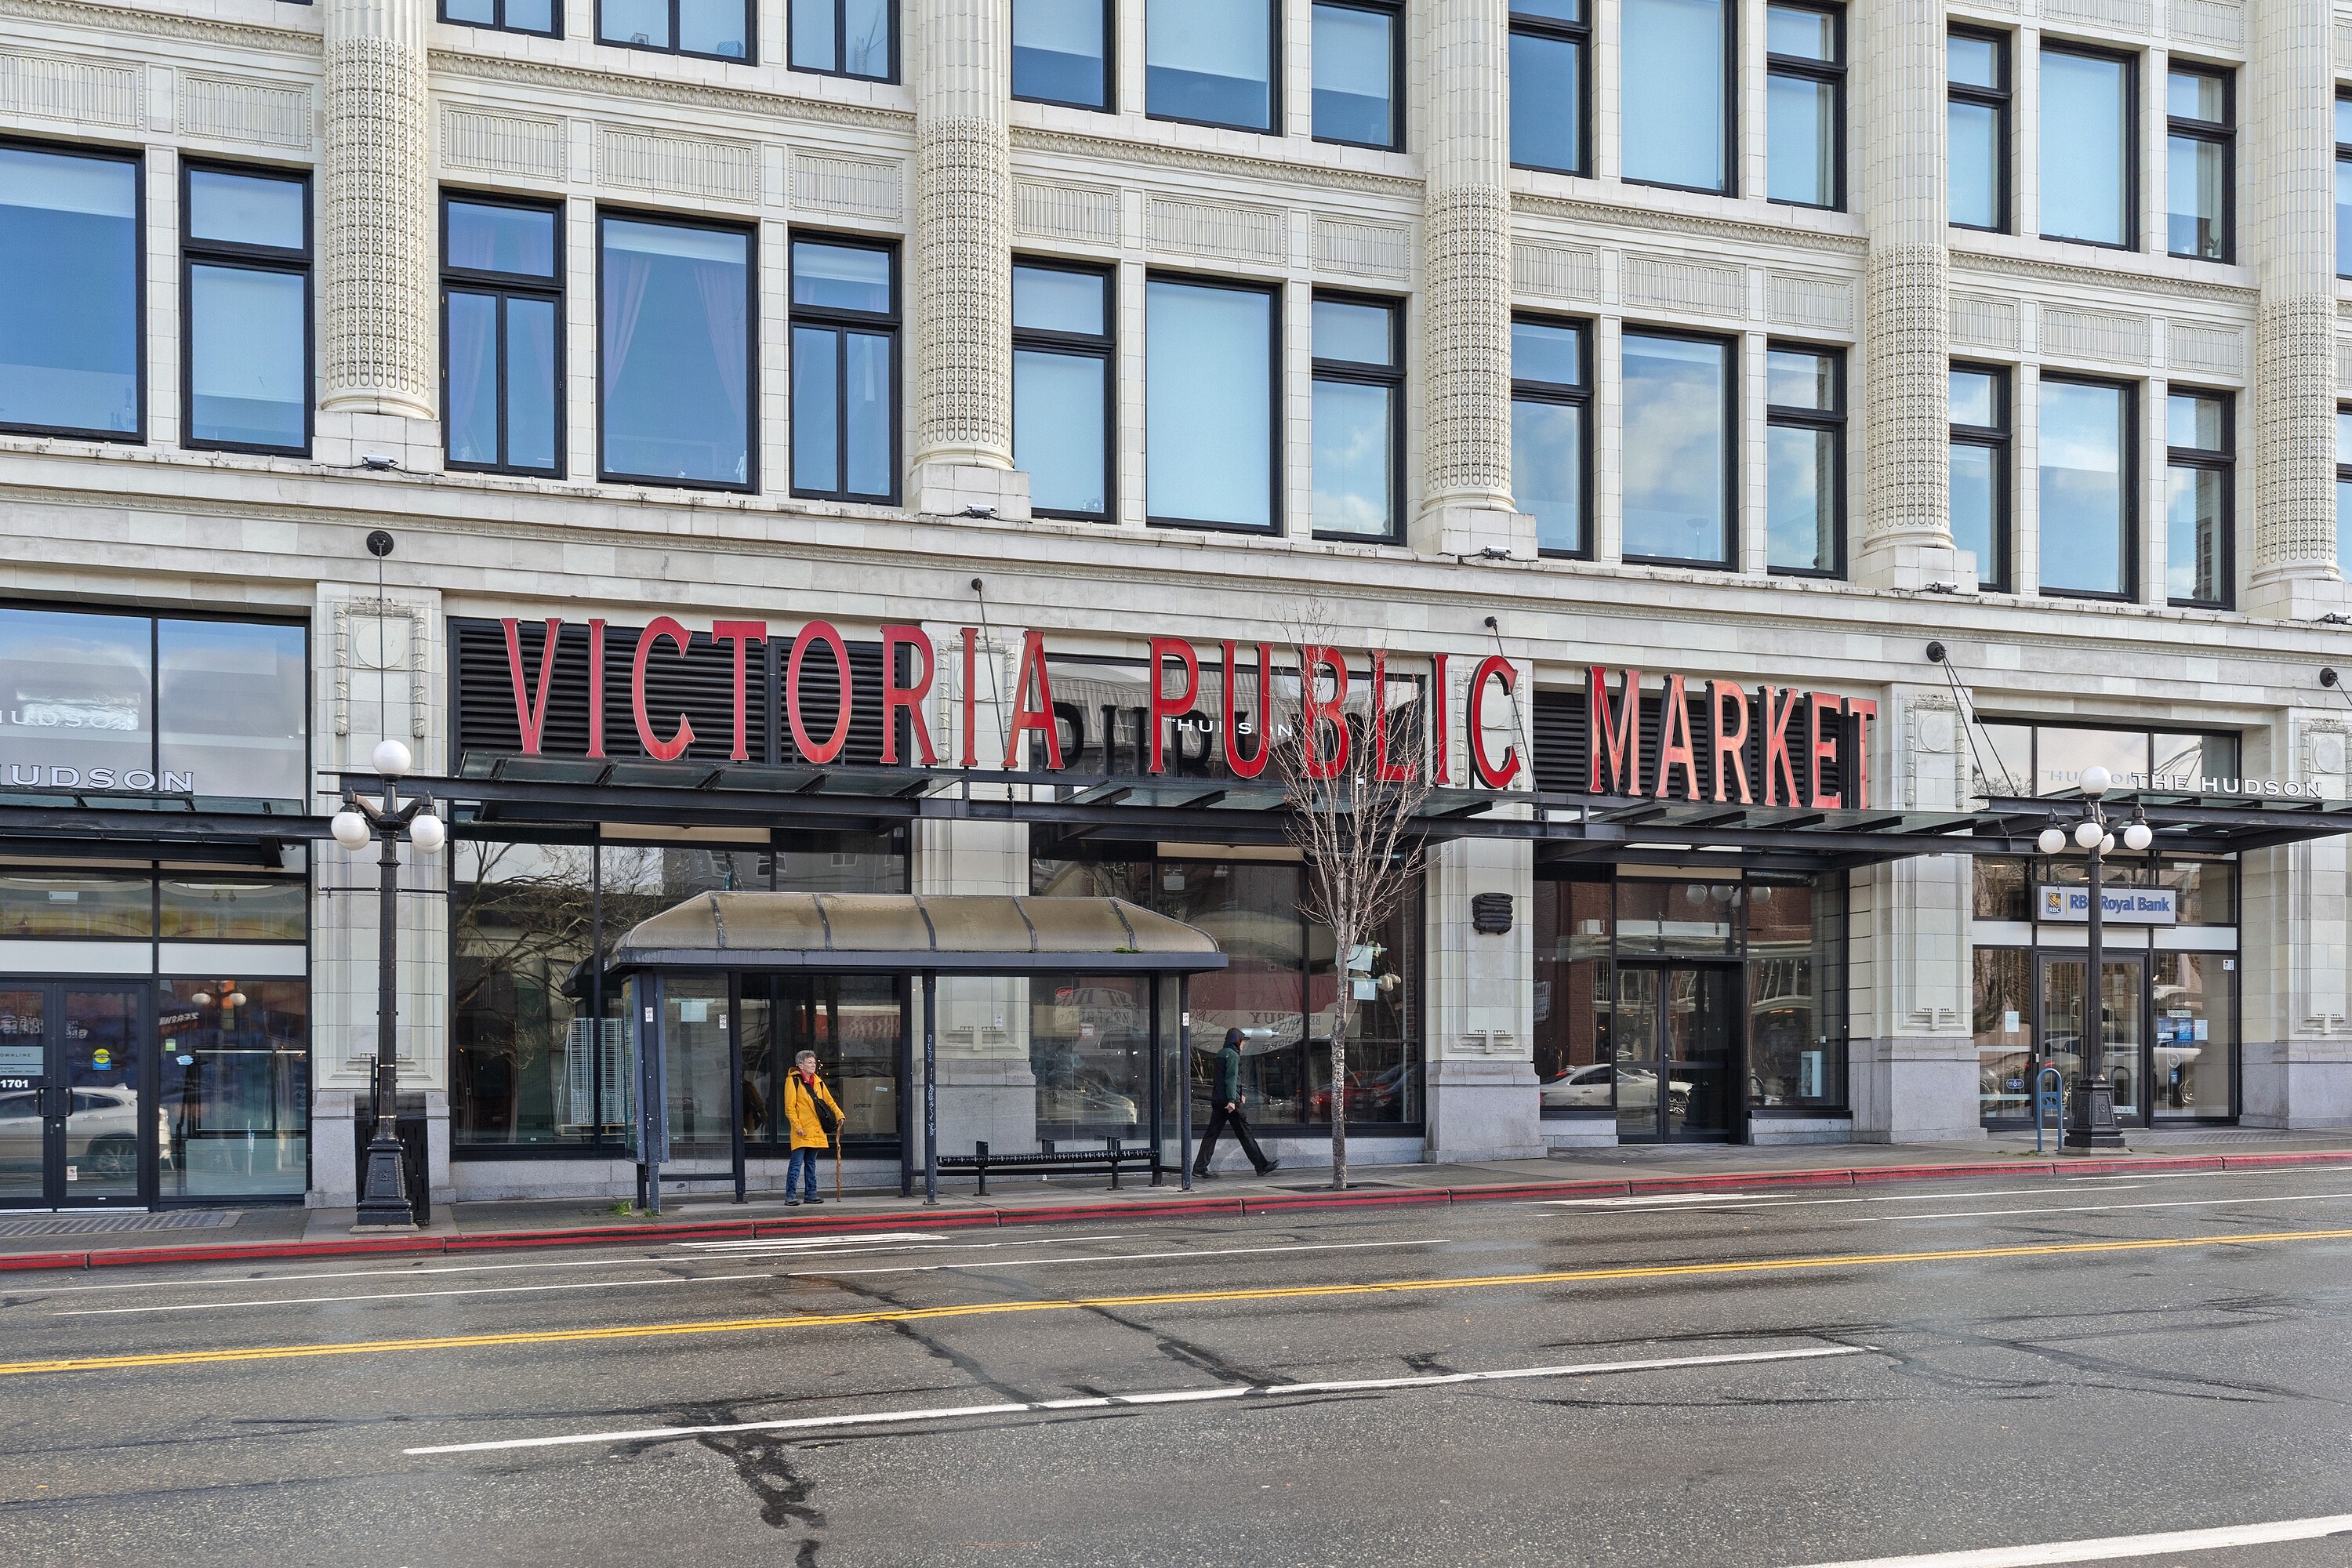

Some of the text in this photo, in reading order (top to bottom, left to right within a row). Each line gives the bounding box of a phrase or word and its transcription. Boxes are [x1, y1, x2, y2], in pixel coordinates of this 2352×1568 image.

[500, 616, 1878, 810] VICTORIA PUBLIC MARKET
[1177, 719, 1293, 737] HUSN
[0, 764, 194, 793] UDSON
[2131, 771, 2323, 800] THE HUDSON
[2069, 895, 2170, 914] RB Royal Bank
[0, 1079, 29, 1088] 1701
